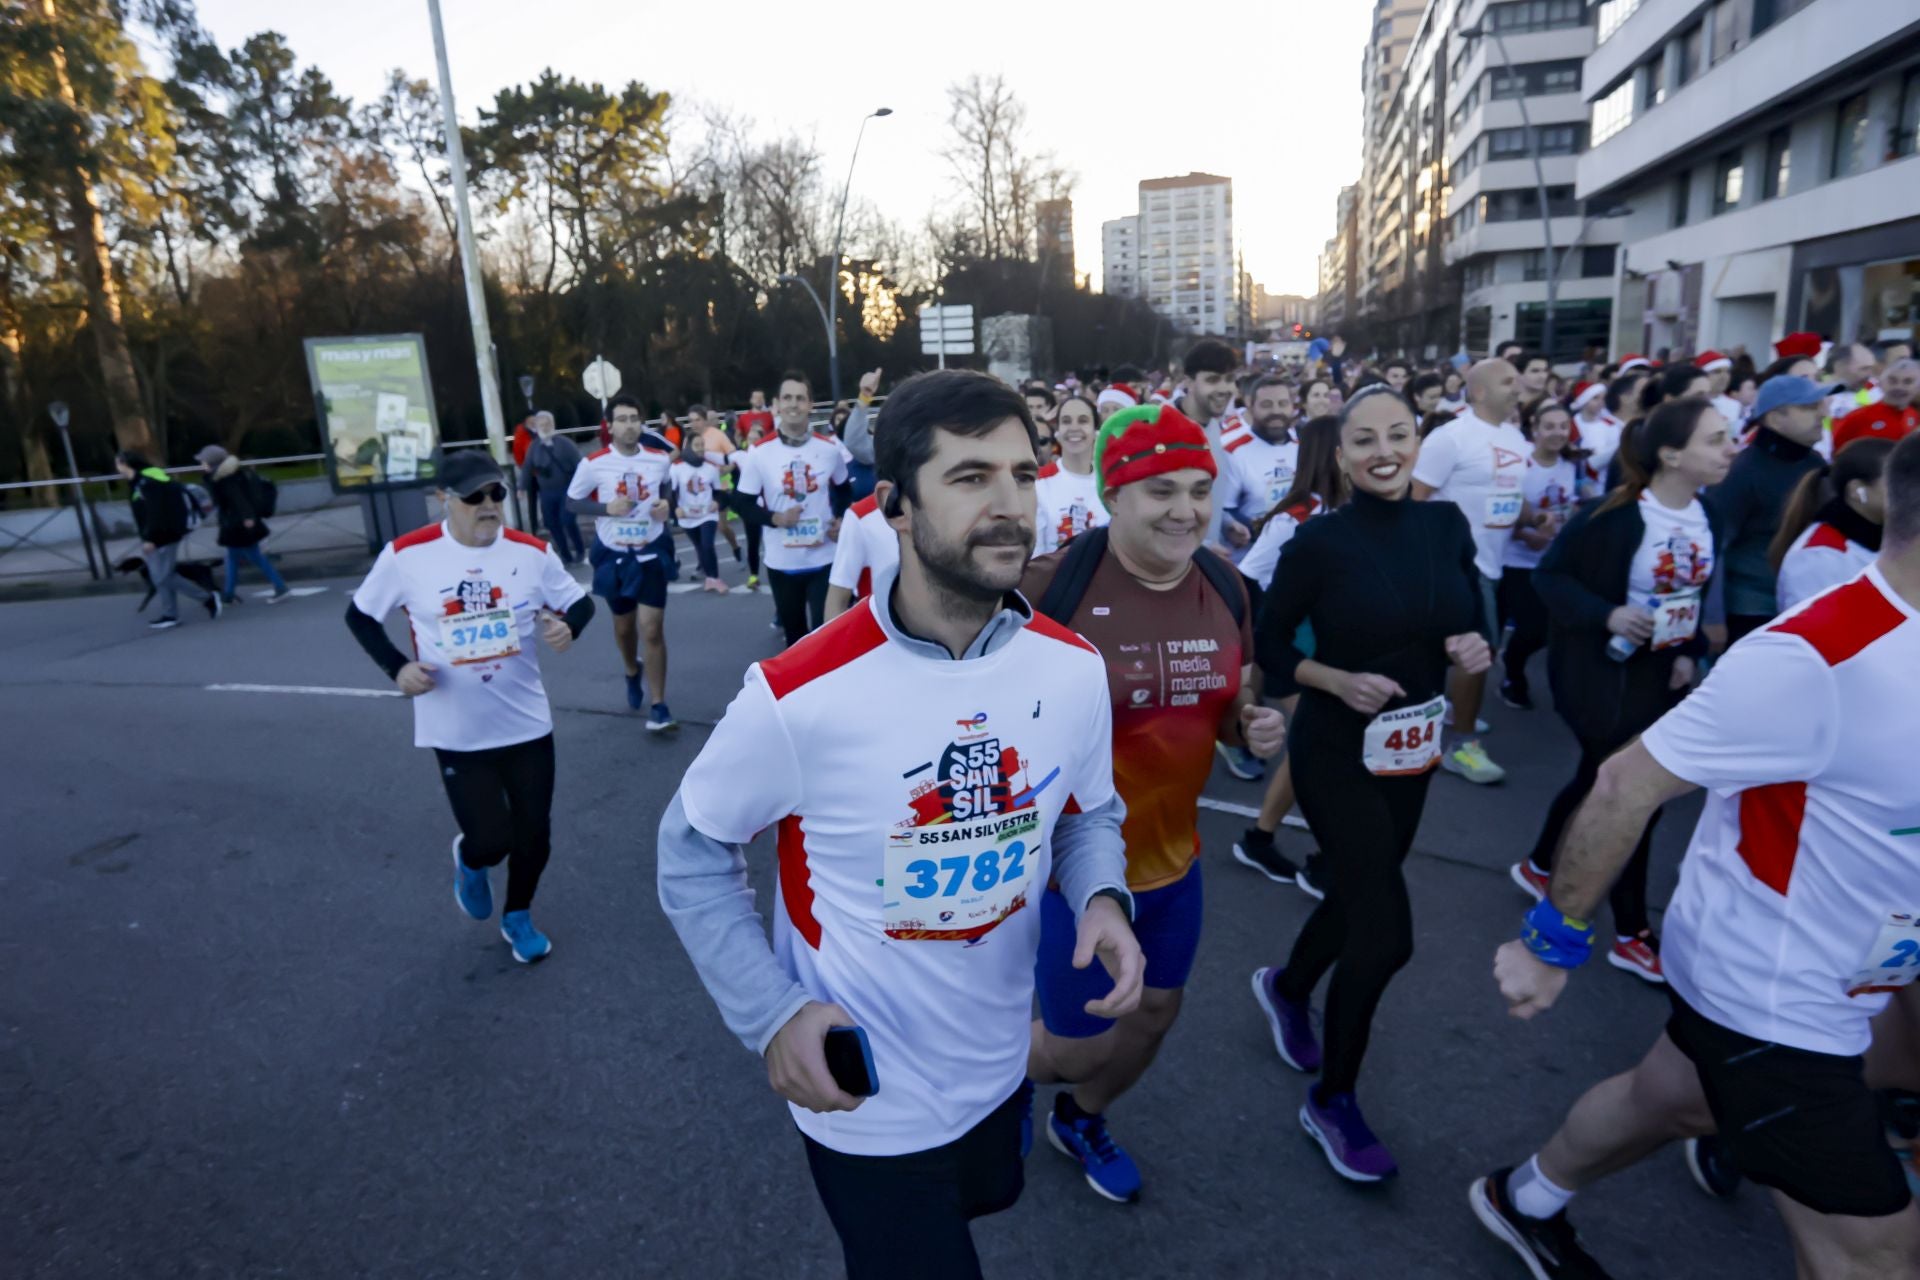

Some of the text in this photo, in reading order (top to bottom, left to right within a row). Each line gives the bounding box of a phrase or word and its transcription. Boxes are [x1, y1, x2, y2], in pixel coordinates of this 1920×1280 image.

[452, 622, 508, 646] 3748
[1183, 639, 1219, 653] MBA
[1170, 656, 1211, 673] media
[1171, 673, 1227, 691] maratón
[1384, 720, 1434, 750] 484
[968, 741, 1001, 768] 55
[949, 764, 999, 791] SAN
[952, 787, 999, 819] SIL
[919, 829, 940, 845] 55
[941, 827, 972, 843] SAN
[974, 810, 1039, 838] SILVESTRE
[904, 840, 1026, 900] 3782
